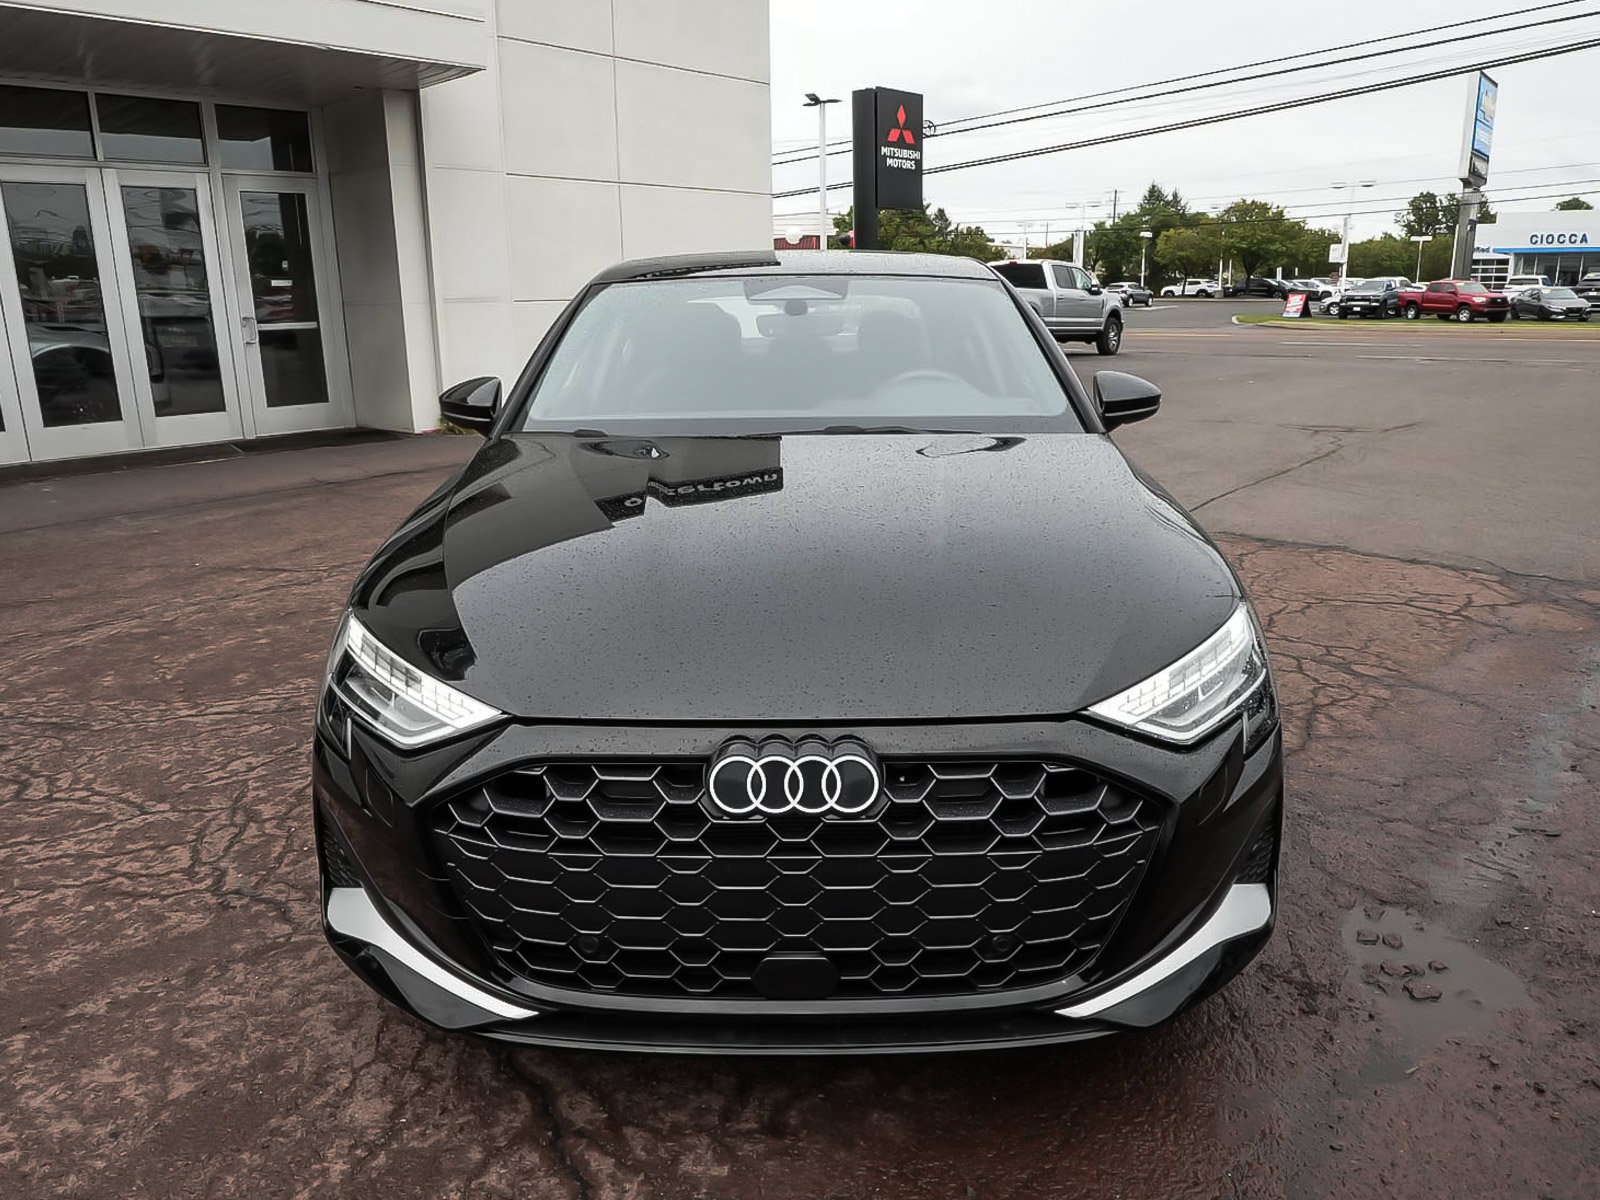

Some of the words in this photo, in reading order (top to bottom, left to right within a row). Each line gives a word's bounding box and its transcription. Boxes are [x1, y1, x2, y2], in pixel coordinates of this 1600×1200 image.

[881, 146, 921, 159] MITSUBISHI
[886, 157, 916, 170] MOTORS
[1529, 233, 1589, 245] CIOCCA
